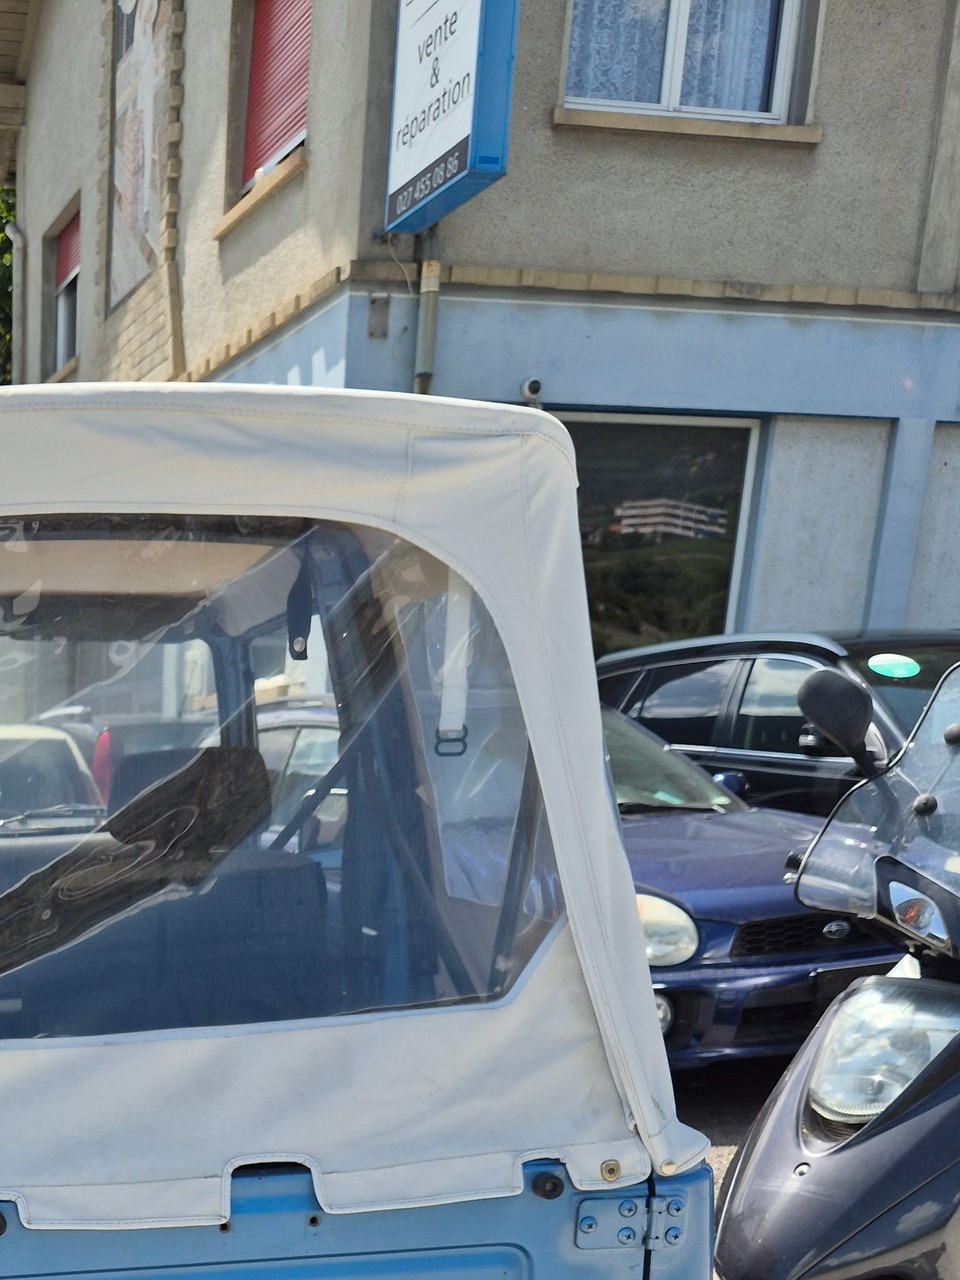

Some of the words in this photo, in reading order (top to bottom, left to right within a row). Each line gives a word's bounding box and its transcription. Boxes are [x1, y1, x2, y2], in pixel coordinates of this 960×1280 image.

[417, 11, 458, 64] vente
[430, 57, 441, 88] &
[395, 72, 470, 151] réparation
[396, 186, 413, 215] 027
[432, 163, 445, 188] 08
[446, 152, 459, 178] 86
